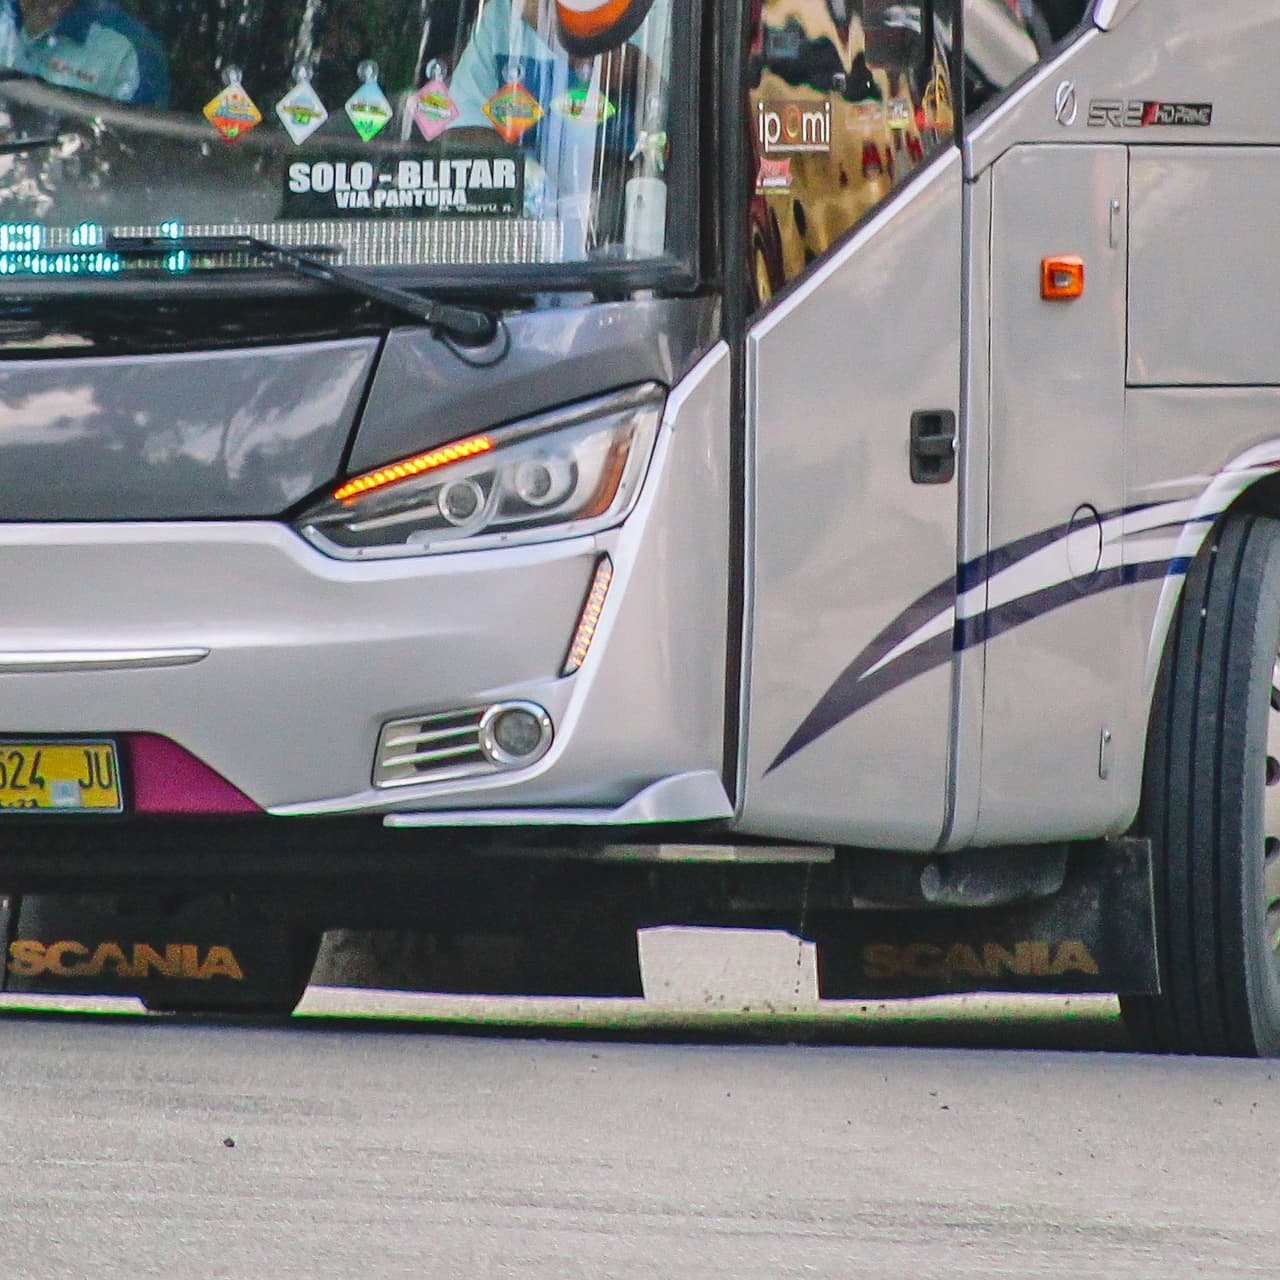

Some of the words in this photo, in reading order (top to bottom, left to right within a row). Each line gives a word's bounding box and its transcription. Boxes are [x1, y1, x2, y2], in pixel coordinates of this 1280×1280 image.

[288, 162, 372, 193] SOLO
[398, 159, 516, 190] BLITAR
[335, 189, 369, 209] VIA
[373, 188, 467, 208] PANTURA
[78, 750, 113, 790] JU
[8, 939, 244, 981] SCANIA
[863, 939, 1101, 980] SCANIA
